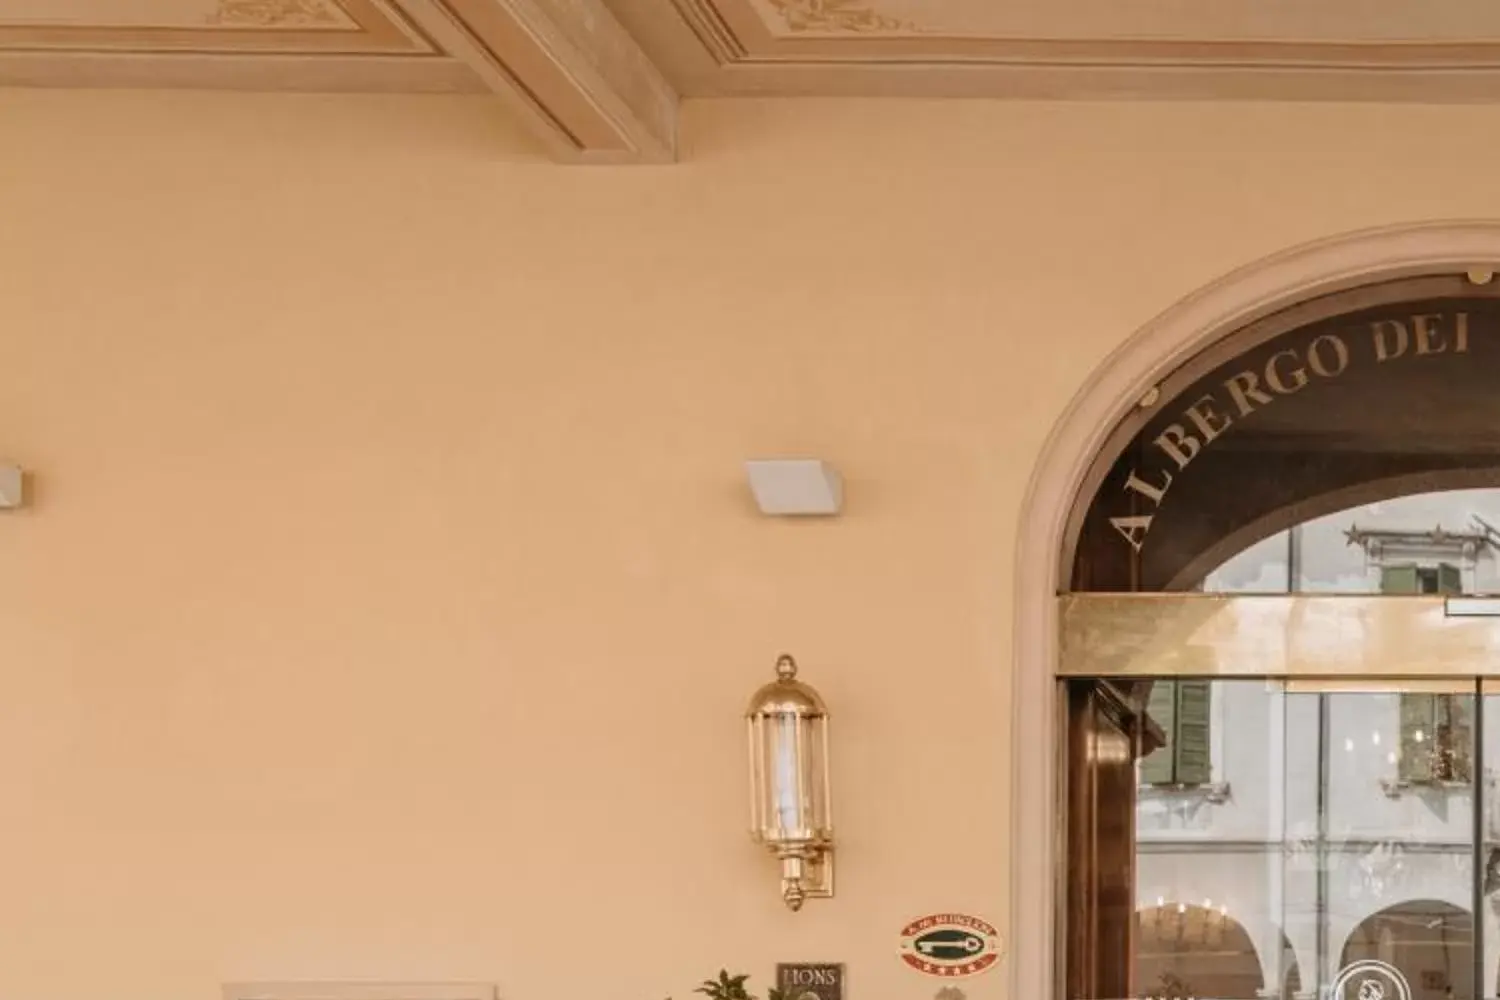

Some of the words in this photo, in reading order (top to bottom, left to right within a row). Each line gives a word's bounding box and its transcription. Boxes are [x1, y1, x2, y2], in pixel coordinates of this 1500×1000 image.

[1108, 334, 1350, 553] ALBERGO
[1370, 312, 1470, 363] DEI
[783, 968, 836, 986] LIONS
